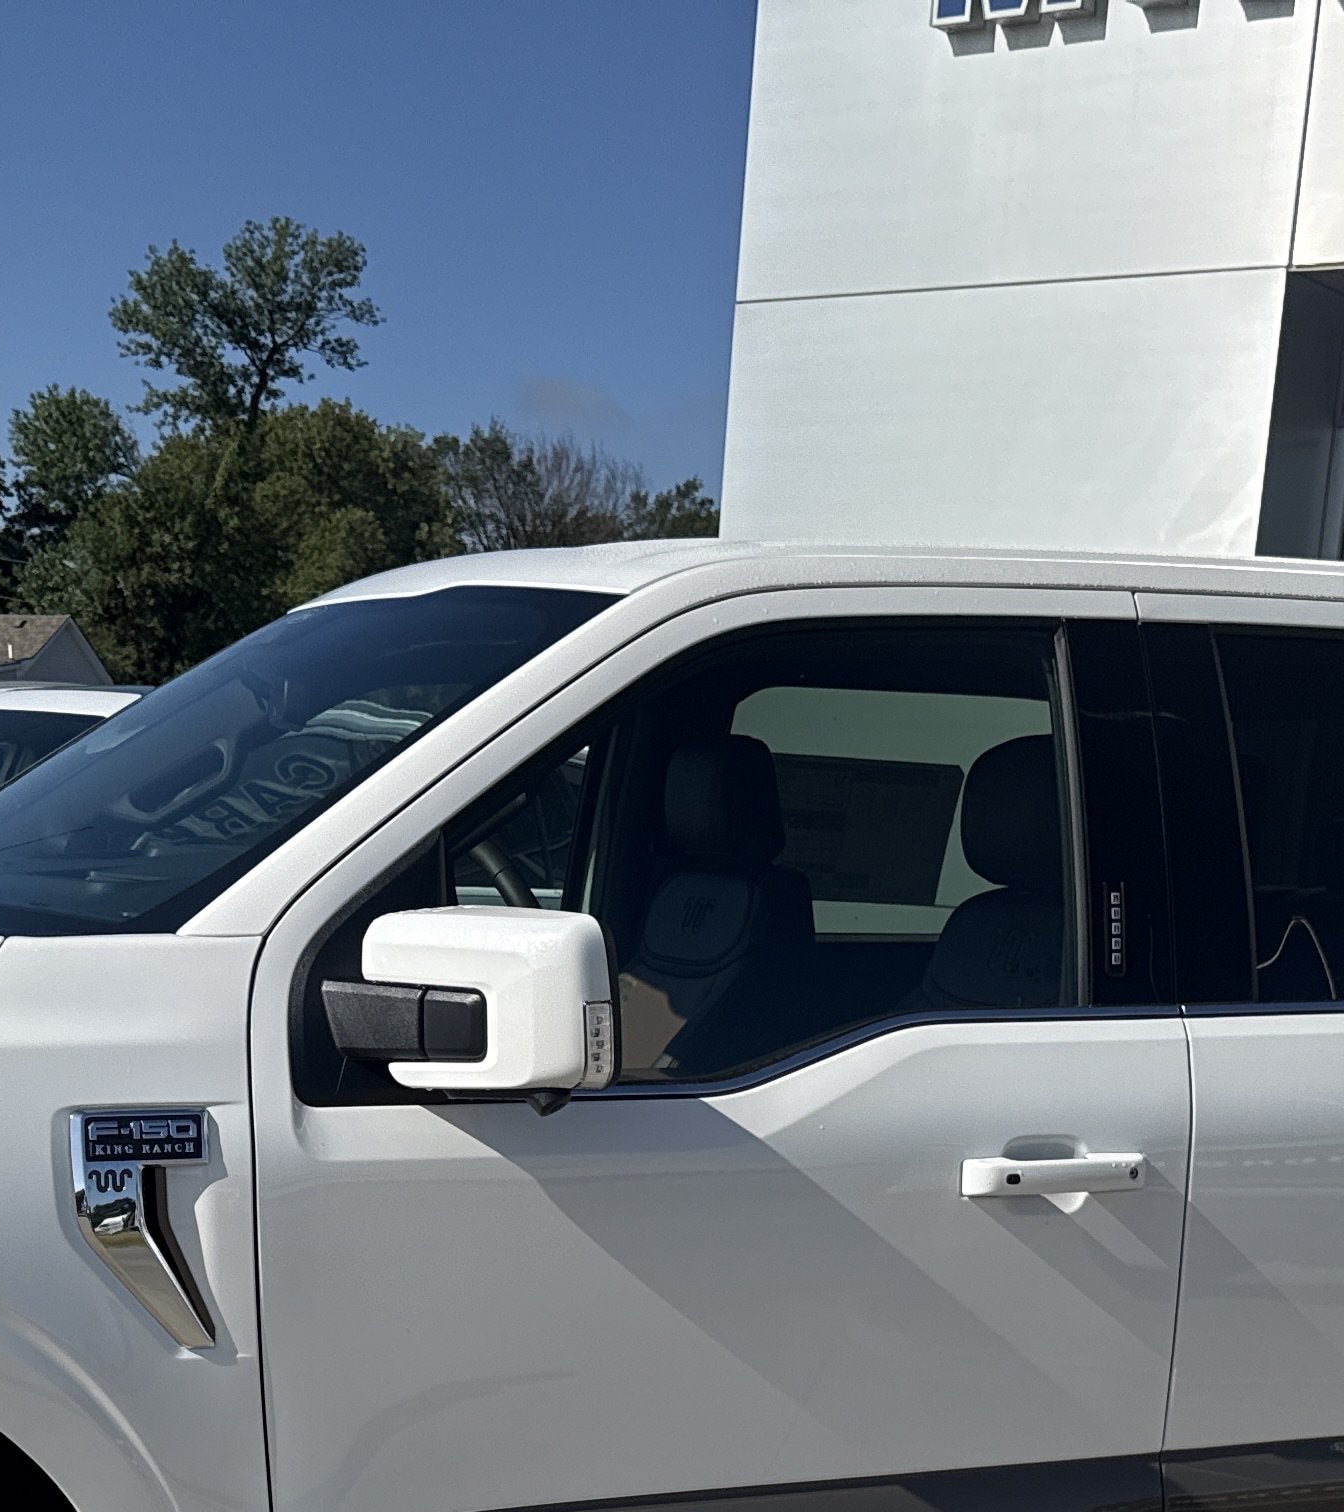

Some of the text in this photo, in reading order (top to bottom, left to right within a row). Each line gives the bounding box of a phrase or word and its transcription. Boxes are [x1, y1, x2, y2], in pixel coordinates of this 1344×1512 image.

[87, 1119, 198, 1141] F-150
[94, 1141, 195, 1156] KING RANCH
